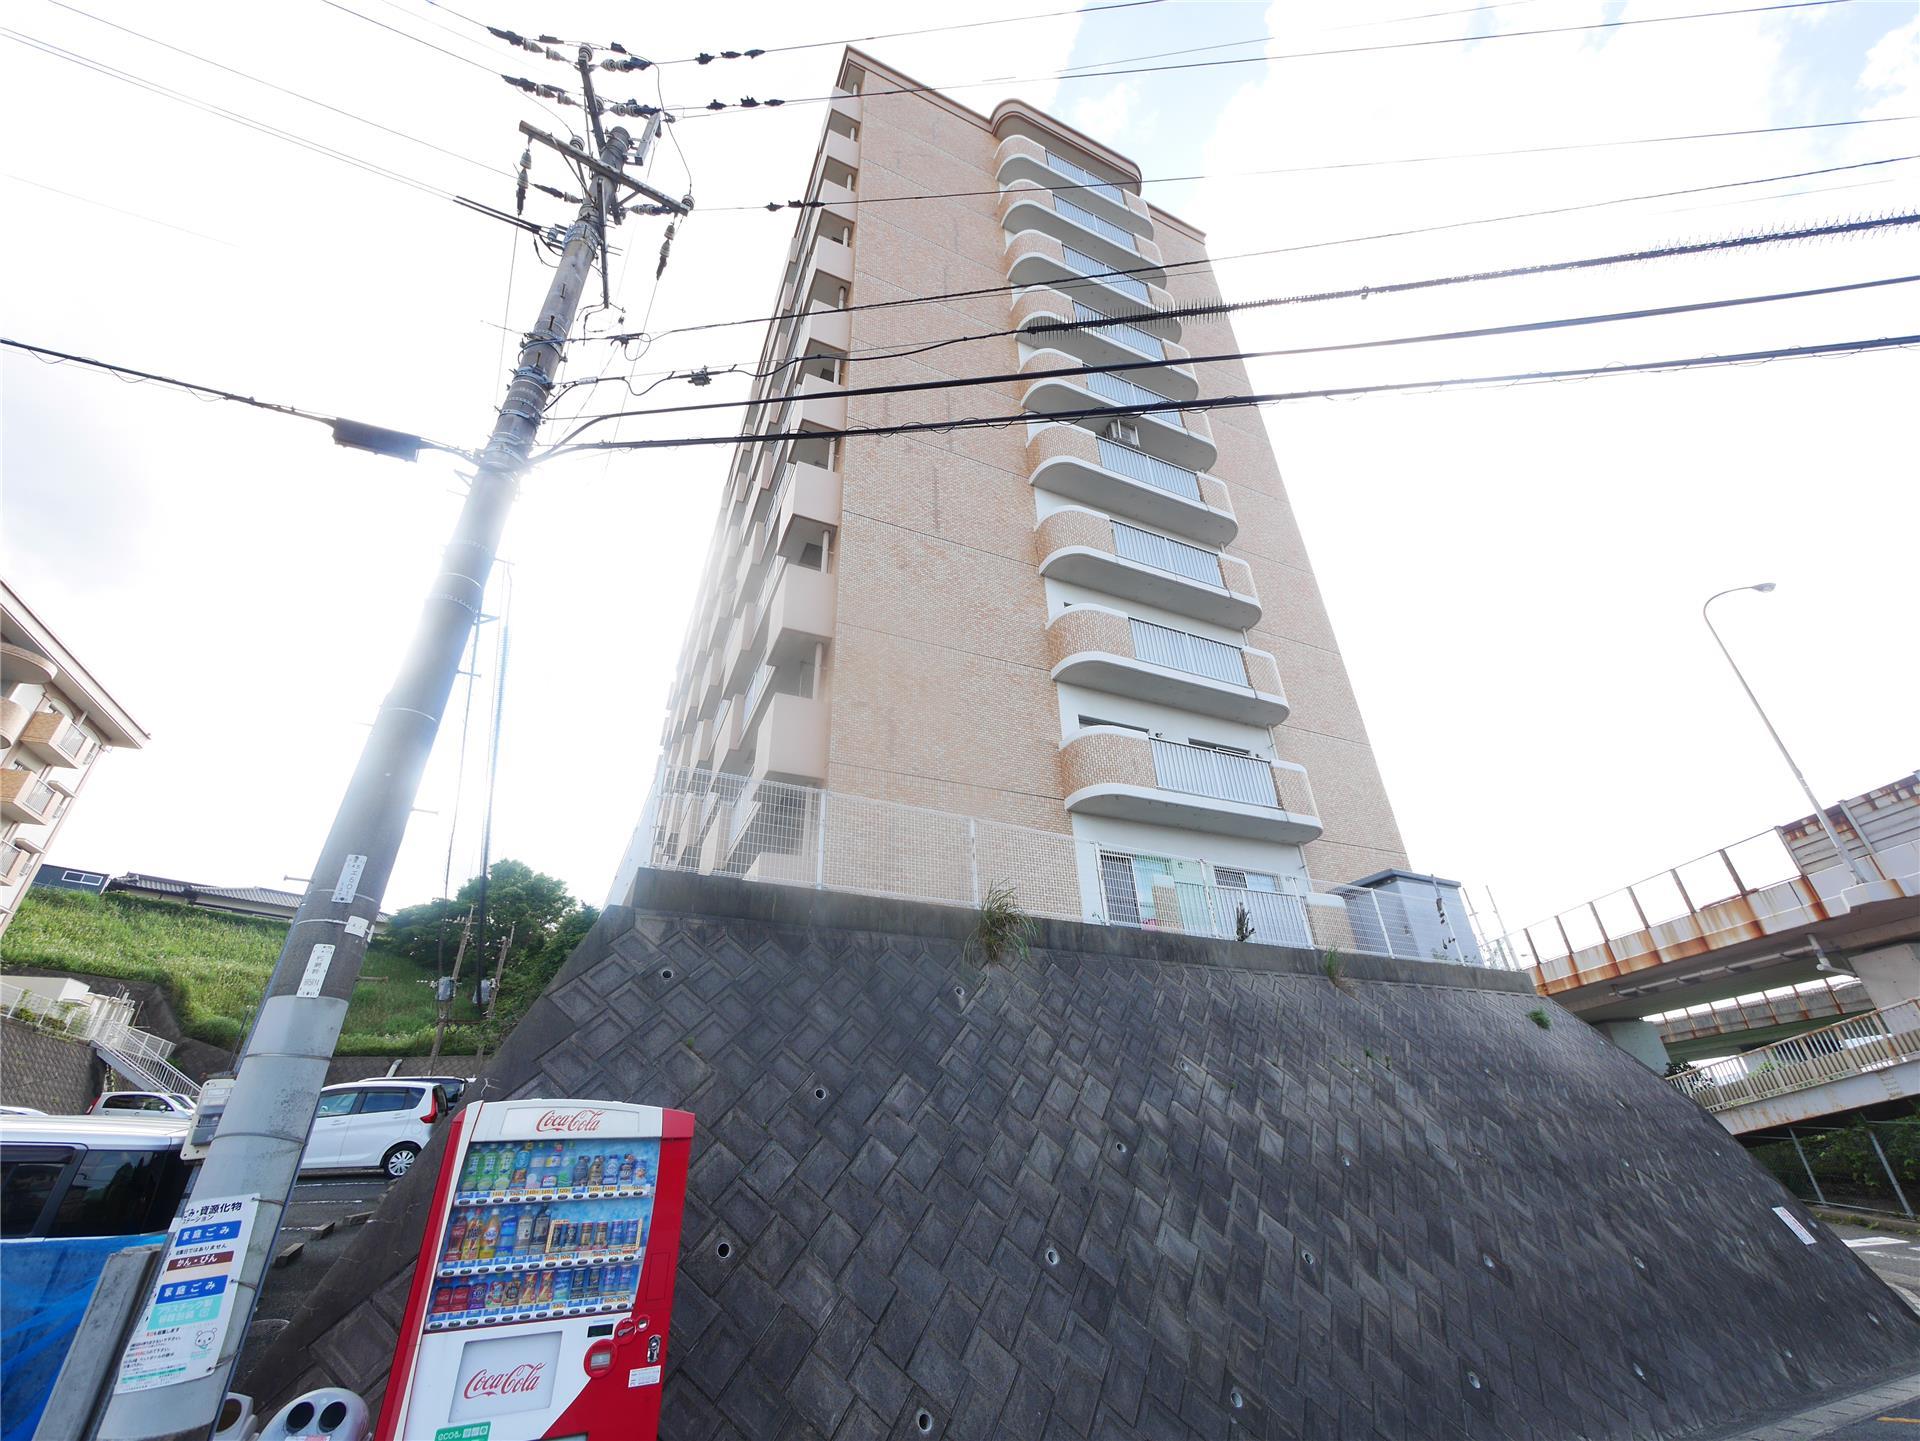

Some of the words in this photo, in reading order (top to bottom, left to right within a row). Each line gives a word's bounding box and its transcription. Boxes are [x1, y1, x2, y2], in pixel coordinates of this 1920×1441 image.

[536, 1108, 607, 1132] Coca-Cola
[181, 1225, 230, 1241] 家庭ごみ
[176, 1254, 218, 1268] かん・びん
[164, 1280, 216, 1298] 家庭ごみ
[464, 1361, 548, 1400] Coca-Cola
